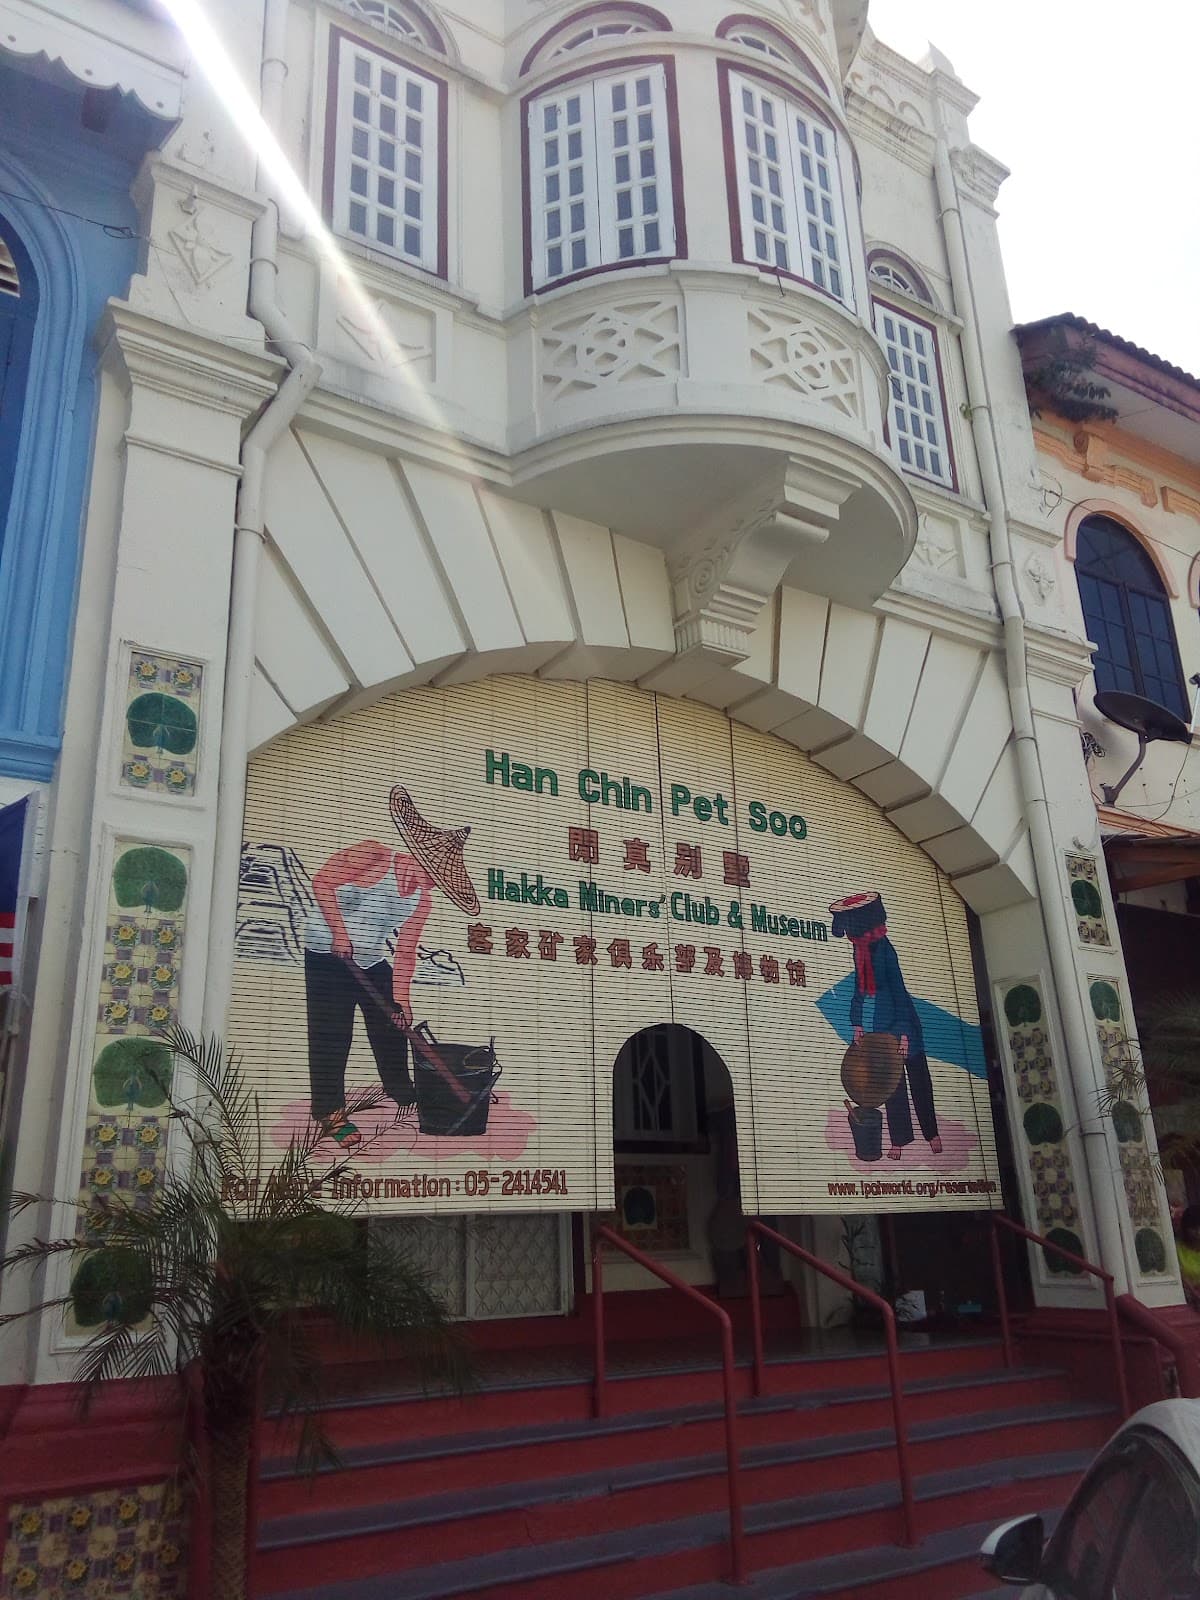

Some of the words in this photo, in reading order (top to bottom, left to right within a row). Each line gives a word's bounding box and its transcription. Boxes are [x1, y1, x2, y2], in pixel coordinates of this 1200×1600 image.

[485, 749, 559, 796] Han
[578, 768, 652, 813] Chin
[670, 783, 729, 825] Pet
[749, 801, 808, 840] Soo
[487, 868, 569, 909] Hakka
[670, 892, 720, 925] Club
[727, 900, 744, 929] &
[751, 904, 828, 942] Museum
